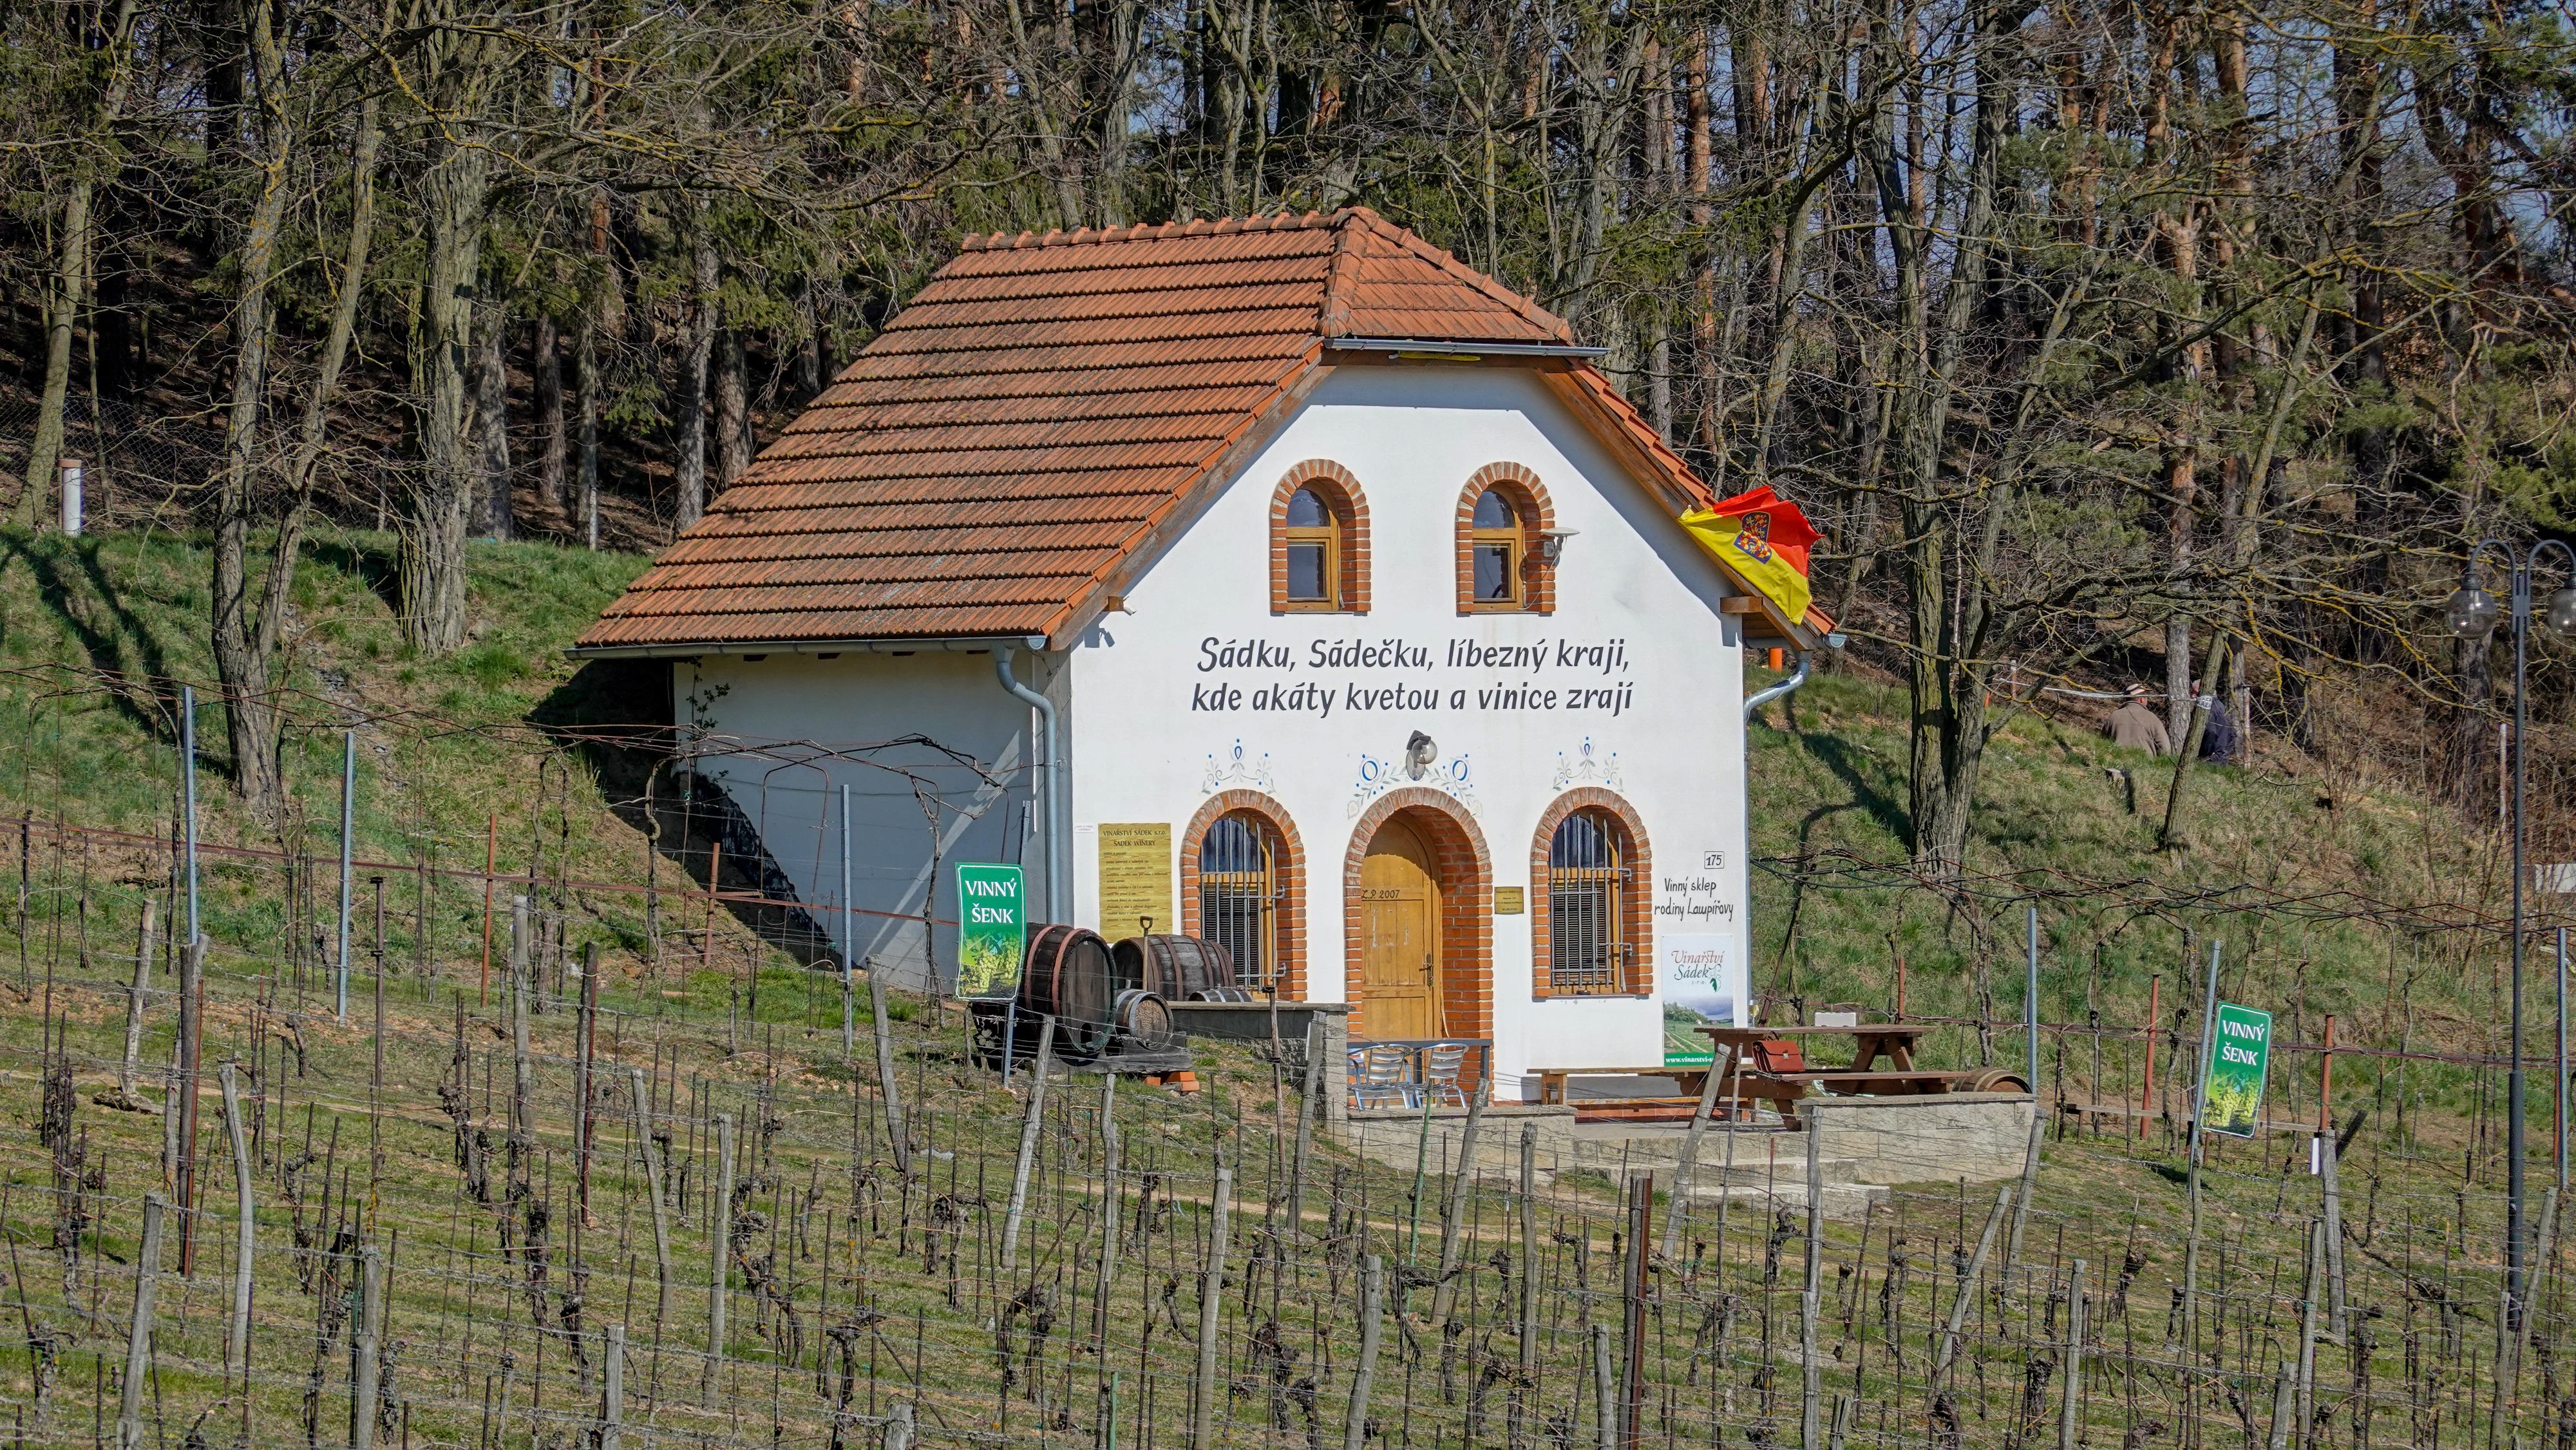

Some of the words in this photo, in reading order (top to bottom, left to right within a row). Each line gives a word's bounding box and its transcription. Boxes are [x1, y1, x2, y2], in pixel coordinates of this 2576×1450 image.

[1197, 636, 1296, 672] Sádku,
[1309, 638, 1434, 671] Sádečku,
[1447, 638, 1548, 673] líbezný
[1557, 638, 1629, 675] kraji,
[1191, 683, 1242, 711] kde
[1252, 682, 1336, 718] akáty
[1347, 683, 1438, 711] kvetou
[1450, 689, 1466, 709] a
[1479, 682, 1557, 710] vinice
[1566, 682, 1633, 717] zrají
[1706, 854, 1722, 866] 175
[965, 877, 1017, 897] VINNÝ
[1379, 889, 1400, 899] 2007
[1664, 876, 1689, 897] Vinný
[1690, 877, 1717, 898] sklep
[972, 902, 1014, 924] ŠENK
[1654, 897, 1684, 922] rodiny
[1671, 950, 1725, 964] Vinařství
[1674, 964, 1710, 980] Sádek
[2222, 1020, 2264, 1042] VINNÝ
[2222, 1042, 2259, 1066] ŠENK
